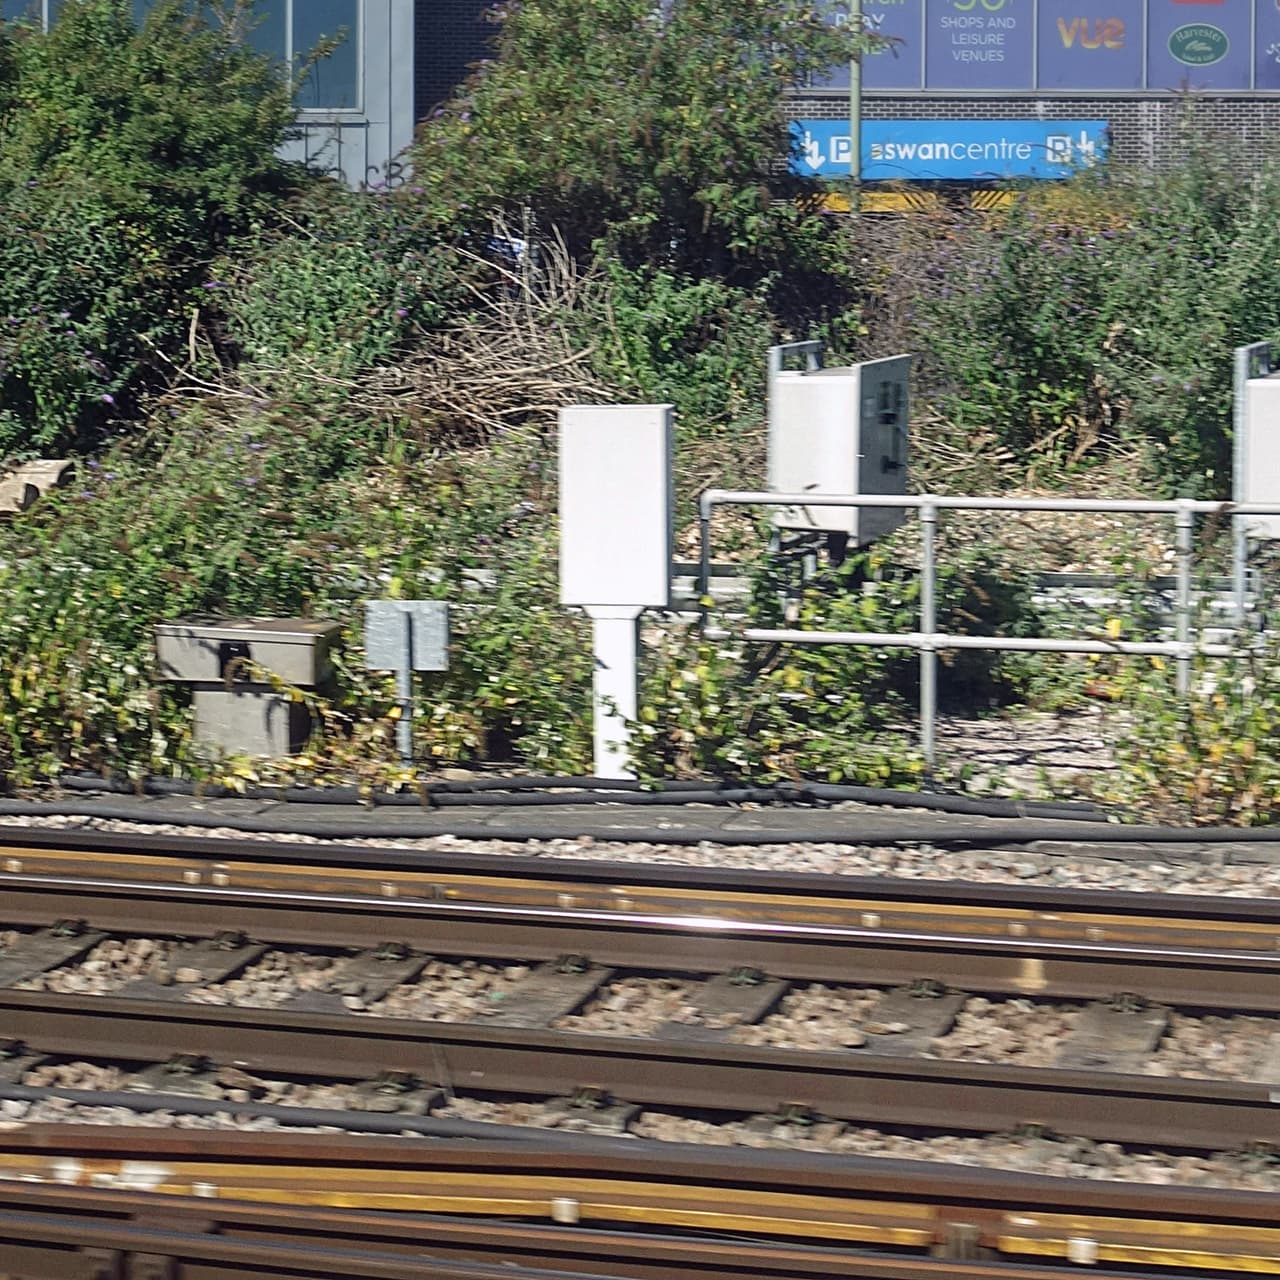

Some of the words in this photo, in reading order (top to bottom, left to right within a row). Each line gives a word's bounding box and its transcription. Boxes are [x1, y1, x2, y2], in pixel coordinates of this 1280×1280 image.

[835, 13, 886, 30] PAY
[941, 16, 984, 29] SHOPS
[987, 16, 1016, 29] AND
[951, 33, 1005, 46] LEISURE
[1176, 28, 1222, 43] Harvester
[952, 49, 1005, 62] VENUES
[884, 137, 1031, 160] swancentre
